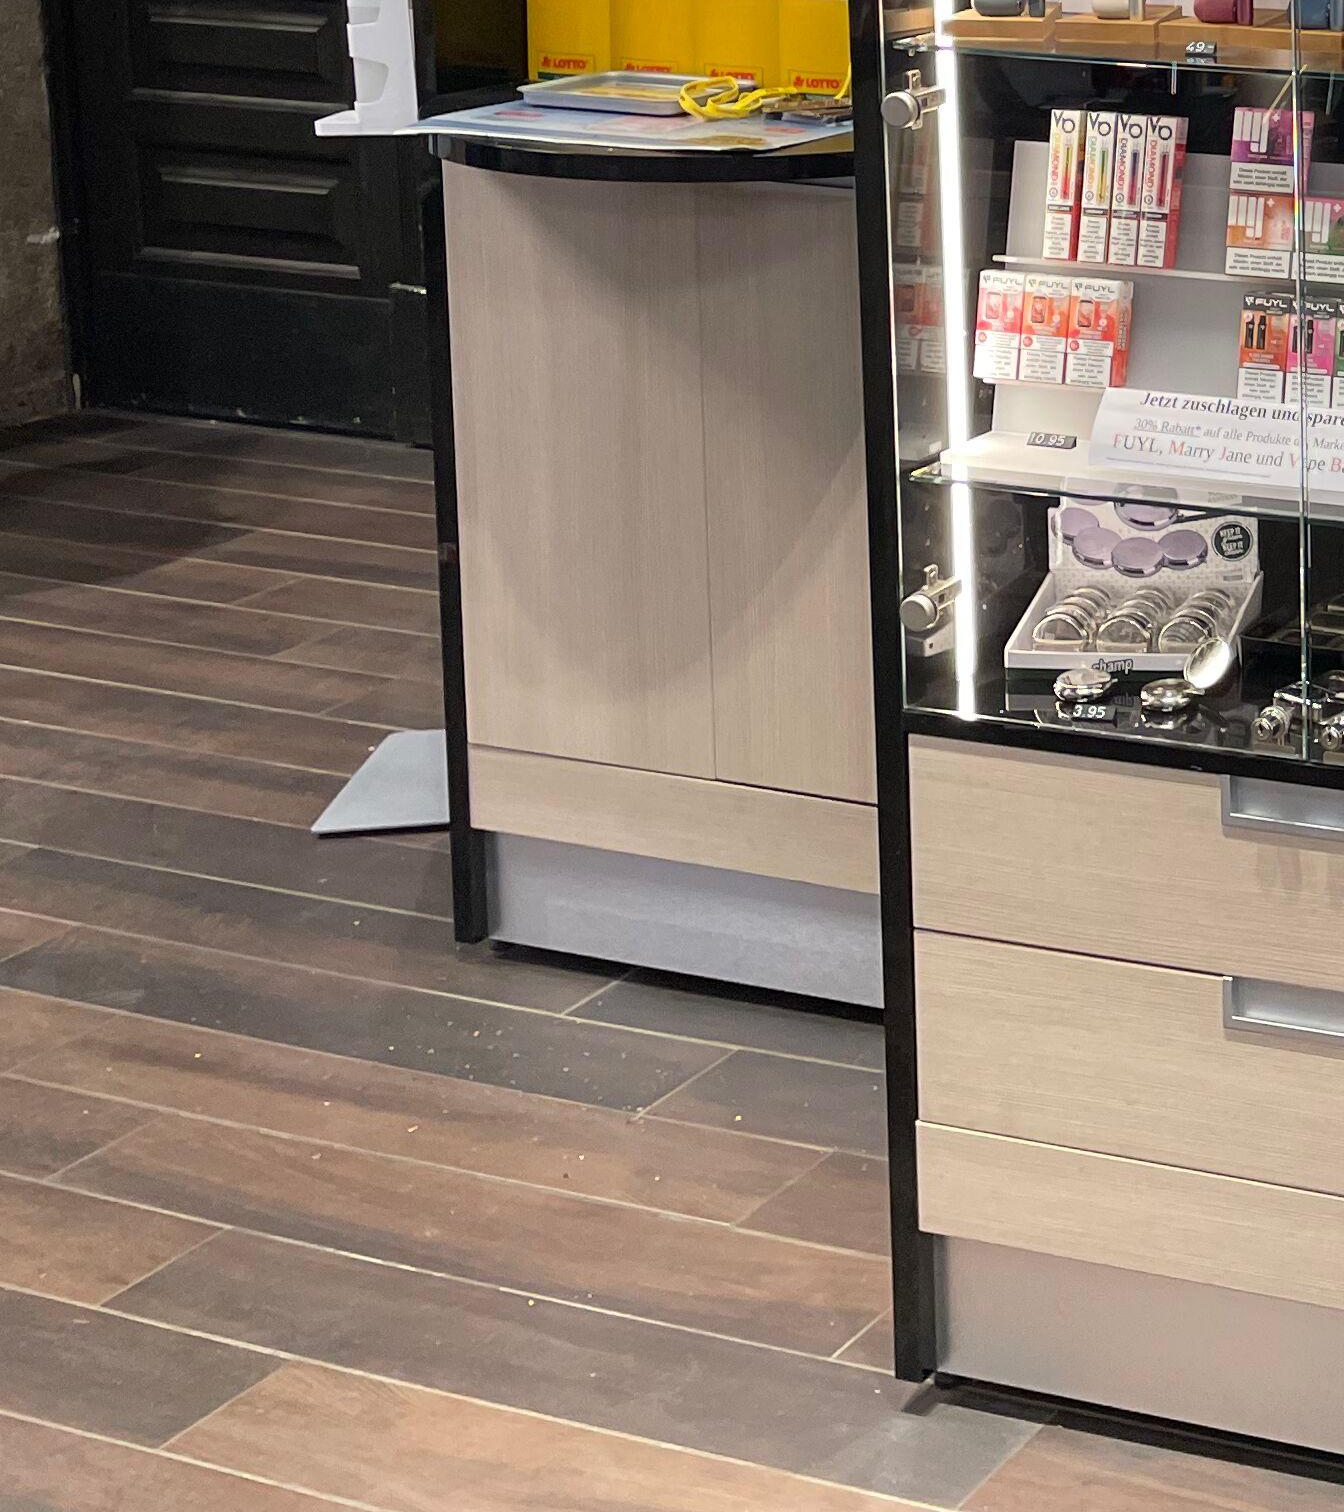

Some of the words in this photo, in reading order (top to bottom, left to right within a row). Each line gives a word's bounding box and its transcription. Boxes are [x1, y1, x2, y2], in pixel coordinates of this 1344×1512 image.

[1140, 392, 1178, 411] Jetzt
[1181, 397, 1267, 421] zuschlagen
[1223, 427, 1243, 442] alle
[1245, 430, 1292, 447] Produkte
[1168, 439, 1216, 463] Marry
[1218, 446, 1252, 465] Jane
[1256, 451, 1284, 467] und
